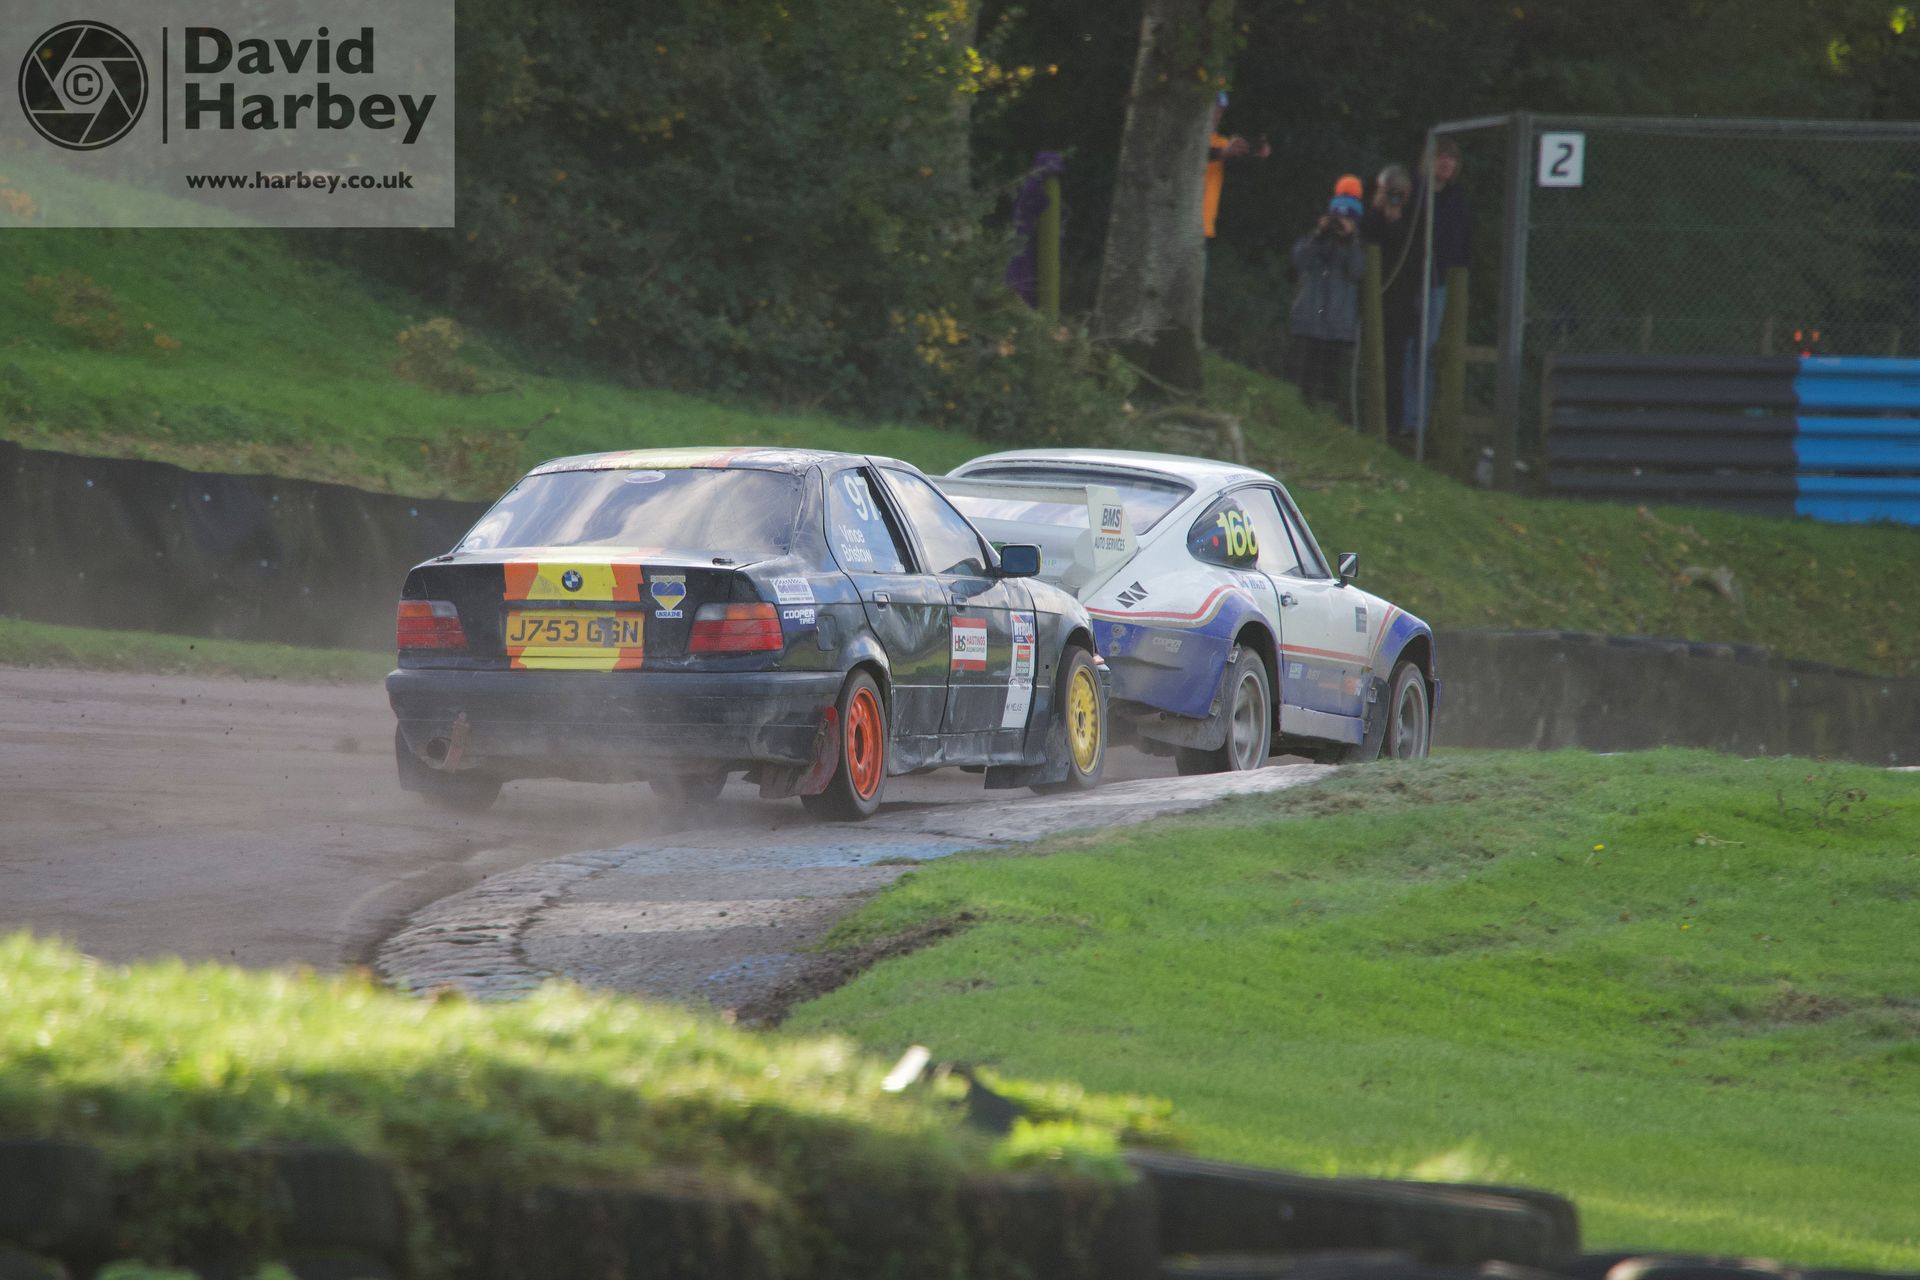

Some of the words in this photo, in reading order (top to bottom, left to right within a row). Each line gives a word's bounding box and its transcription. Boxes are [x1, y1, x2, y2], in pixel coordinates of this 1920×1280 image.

[1549, 142, 1575, 177] 2
[843, 475, 880, 521] 97
[1102, 507, 1121, 528] BMS
[1094, 536, 1105, 550] AUTO
[1105, 537, 1125, 552] SERVICES
[783, 608, 815, 619] COOPER
[510, 619, 579, 642] J753
